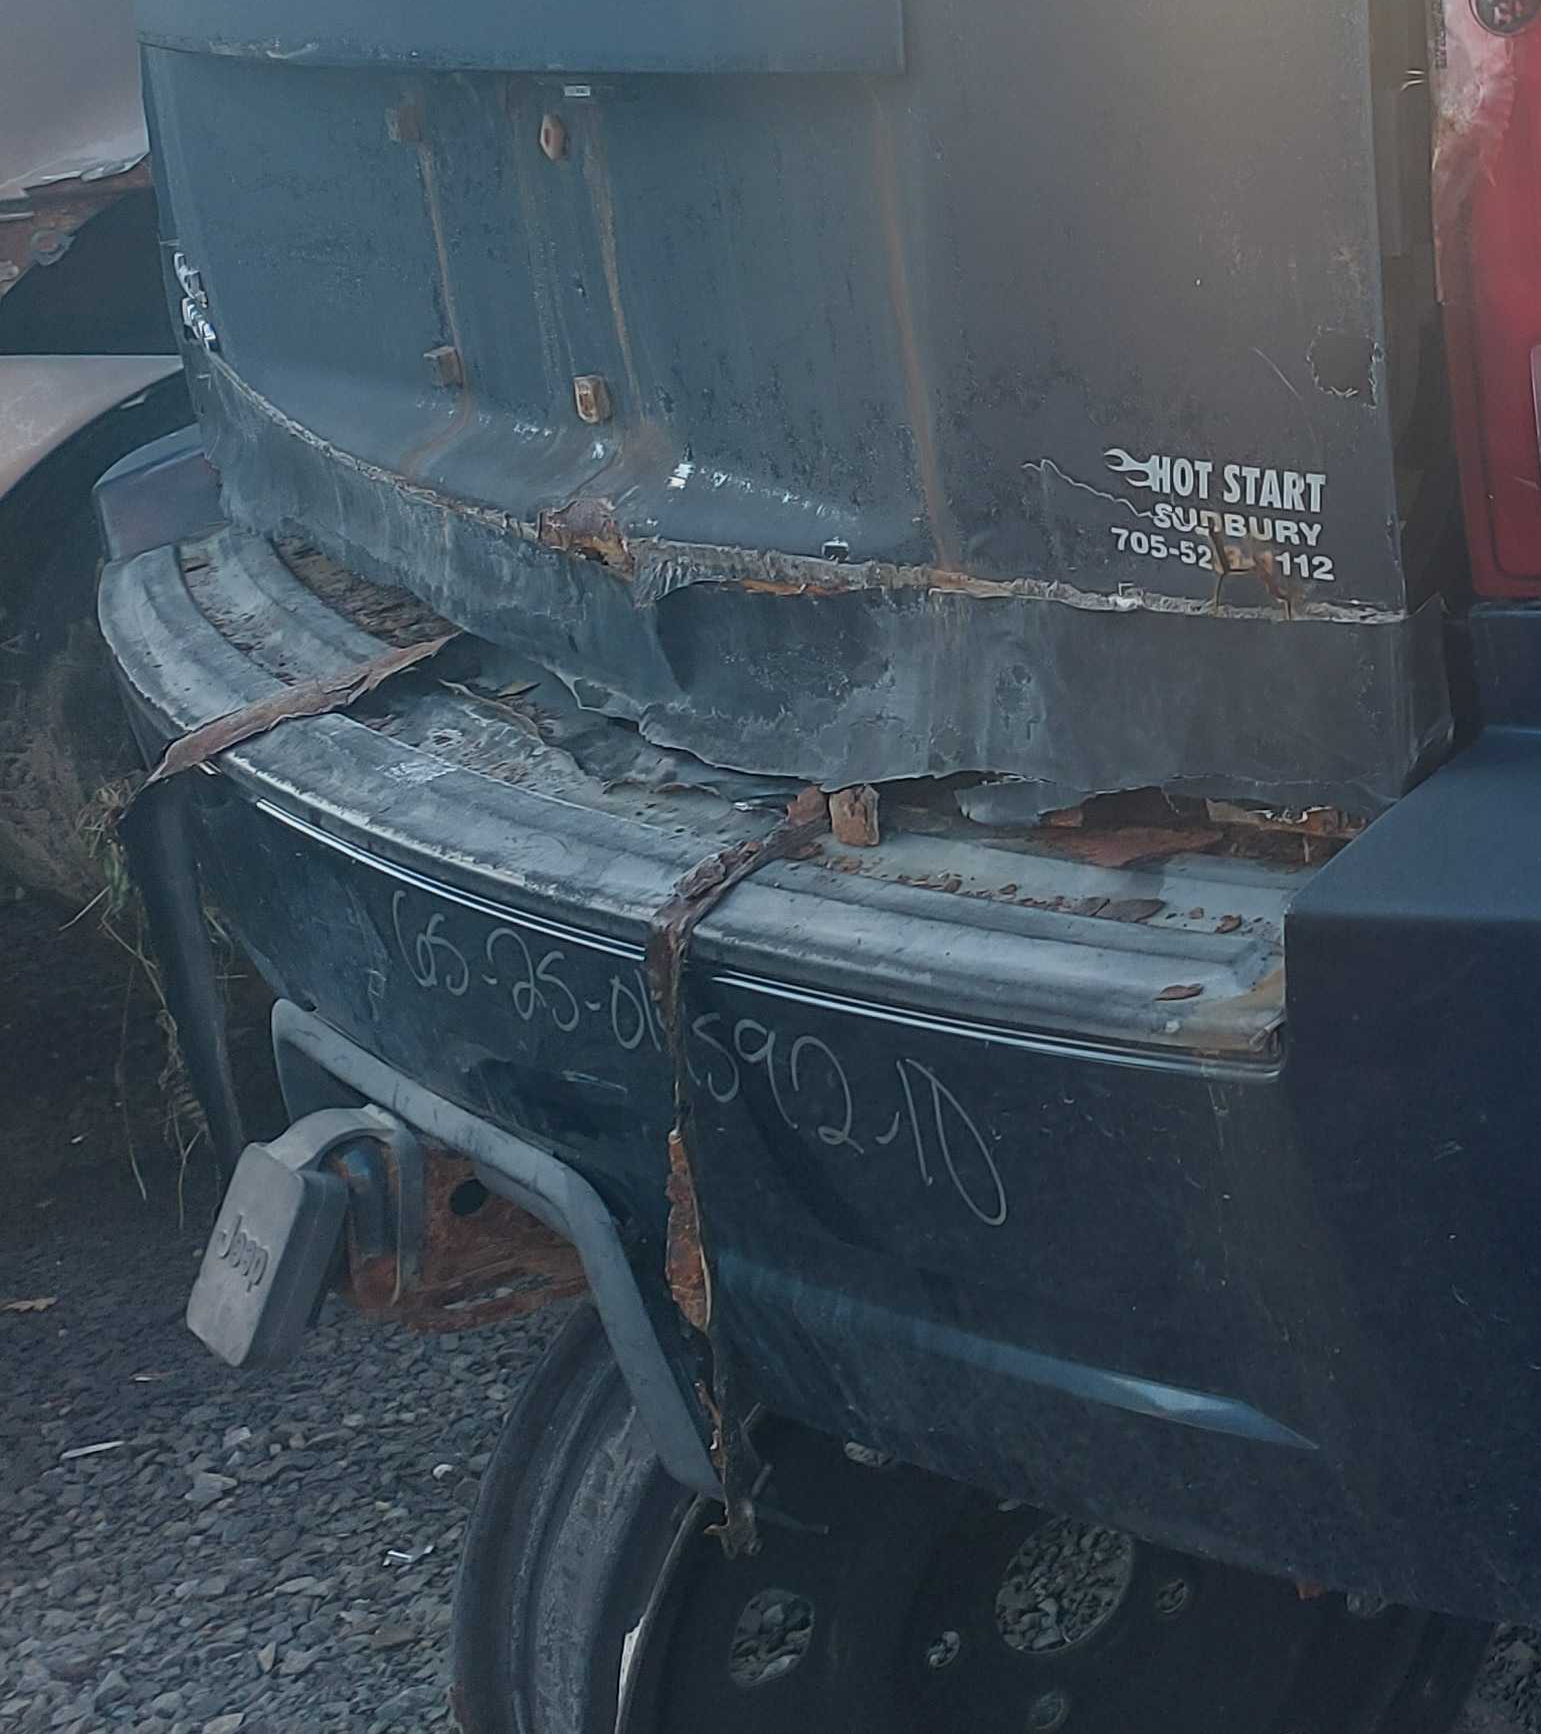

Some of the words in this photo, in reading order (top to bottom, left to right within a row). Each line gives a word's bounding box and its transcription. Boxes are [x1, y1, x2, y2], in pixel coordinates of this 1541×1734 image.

[1149, 453, 1213, 501] HOT
[1223, 463, 1327, 514] START
[1152, 502, 1322, 547] SUDBURY
[391, 888, 1007, 1228] 65-25-01592-10
[217, 1212, 269, 1298] Jeep
